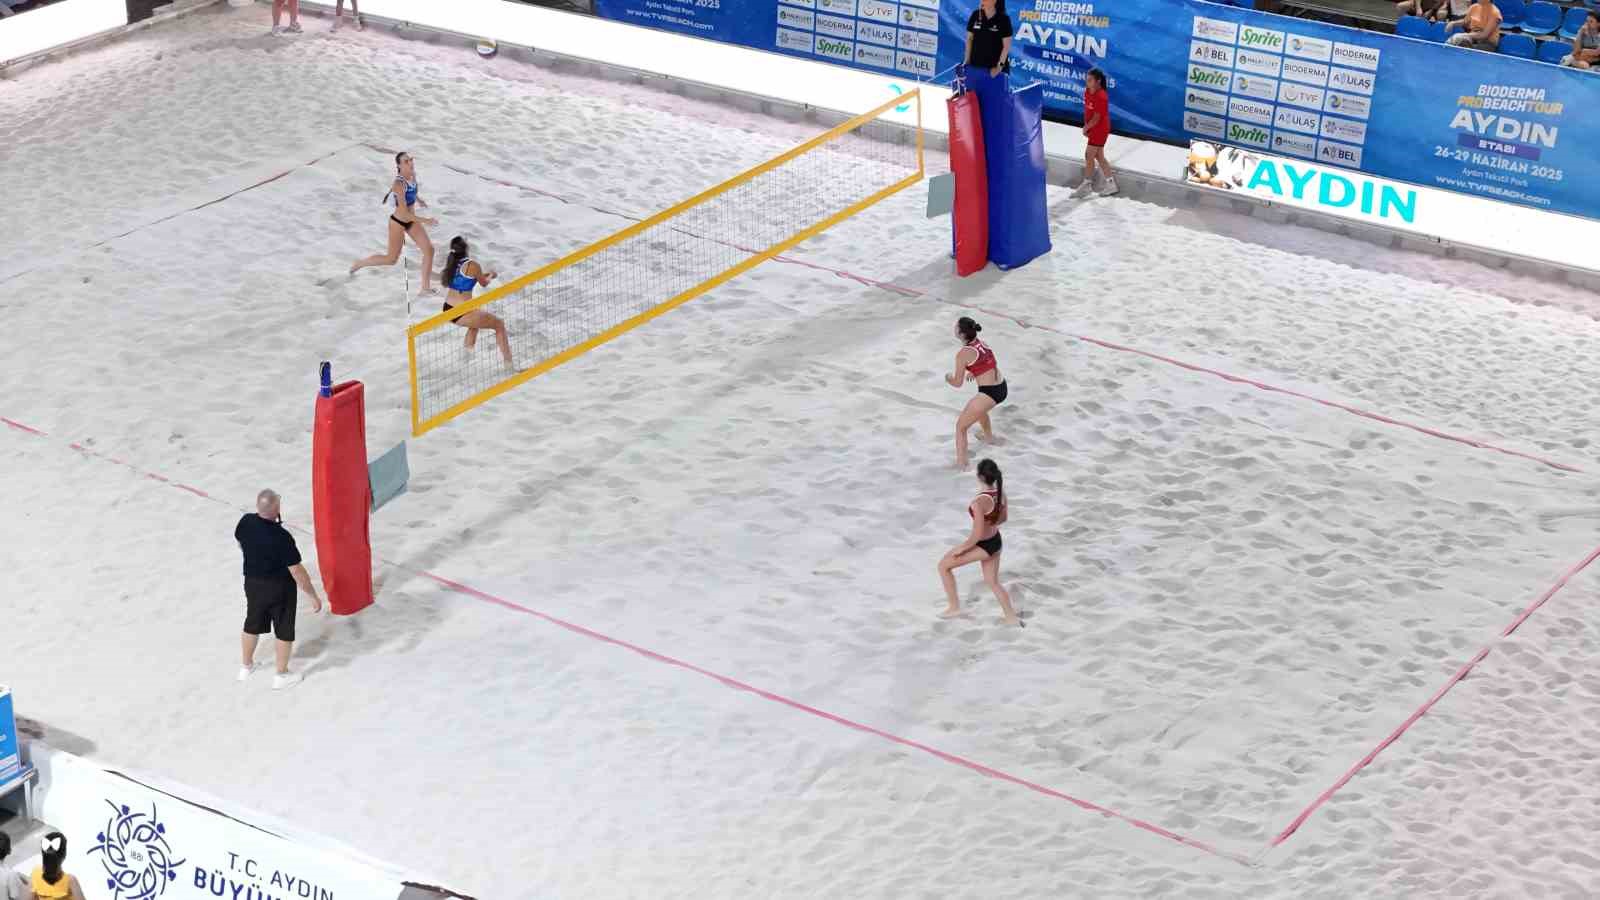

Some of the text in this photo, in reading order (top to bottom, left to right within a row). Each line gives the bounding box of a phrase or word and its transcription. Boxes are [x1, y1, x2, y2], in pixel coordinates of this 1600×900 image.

[876, 7, 893, 16] TVF
[1034, 0, 1094, 15] BIODERMA
[817, 17, 852, 31] BIODERMA
[1015, 22, 1107, 58] AYDIN
[1241, 28, 1282, 47] Sprite
[816, 38, 852, 57] Sprite
[1335, 48, 1377, 62] BIODERMA
[1189, 67, 1229, 86] Sprite
[1284, 64, 1326, 78] BIODERMA
[1300, 92, 1319, 103] TVF
[1478, 84, 1545, 100] BIODERMA
[1231, 103, 1271, 117] BIODERMA
[1229, 124, 1269, 143] Sprite
[1449, 109, 1558, 148] AYDIN
[1434, 145, 1564, 181] 26-29 HAZİRAN 2025
[1247, 159, 1417, 223] AYDIN
[228, 851, 334, 900] T.C. AYDIN
